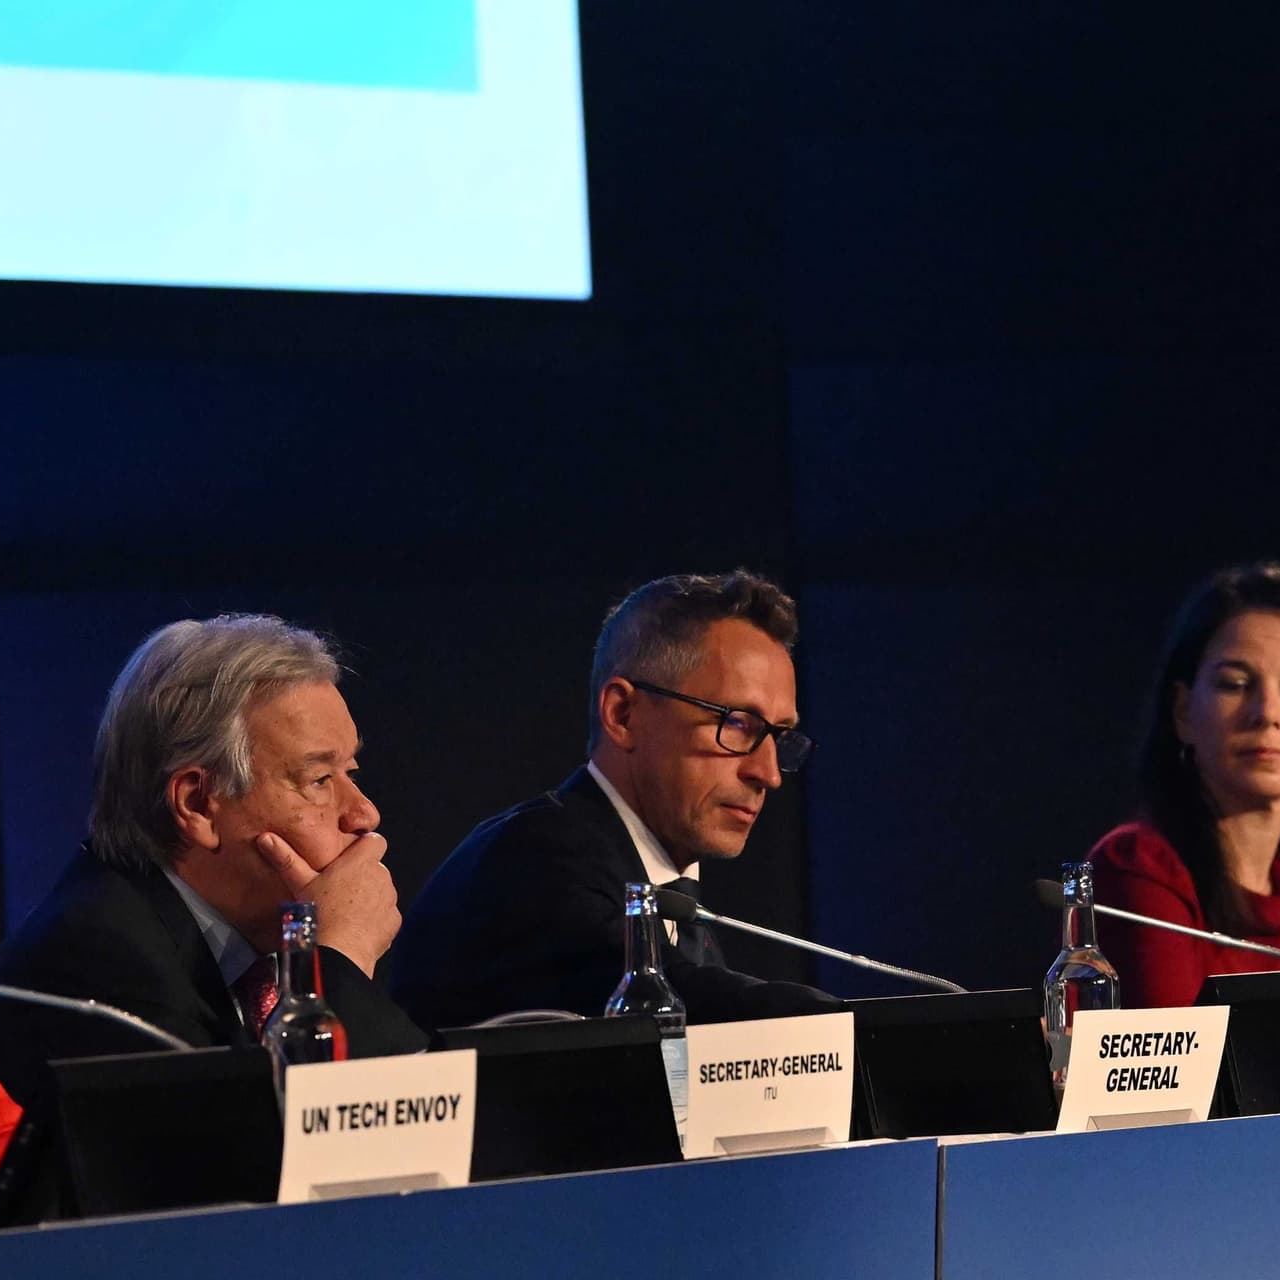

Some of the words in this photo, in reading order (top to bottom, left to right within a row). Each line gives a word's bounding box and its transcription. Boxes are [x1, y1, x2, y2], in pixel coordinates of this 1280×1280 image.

[1099, 1031, 1199, 1059] SECRETARY-
[699, 1052, 842, 1084] SECRETARY-GENERAL
[1106, 1065, 1179, 1092] GENERAL
[764, 1086, 778, 1101] ITU
[302, 1107, 330, 1135] UN
[337, 1101, 388, 1131] TECH
[395, 1094, 461, 1125] ENVOY
